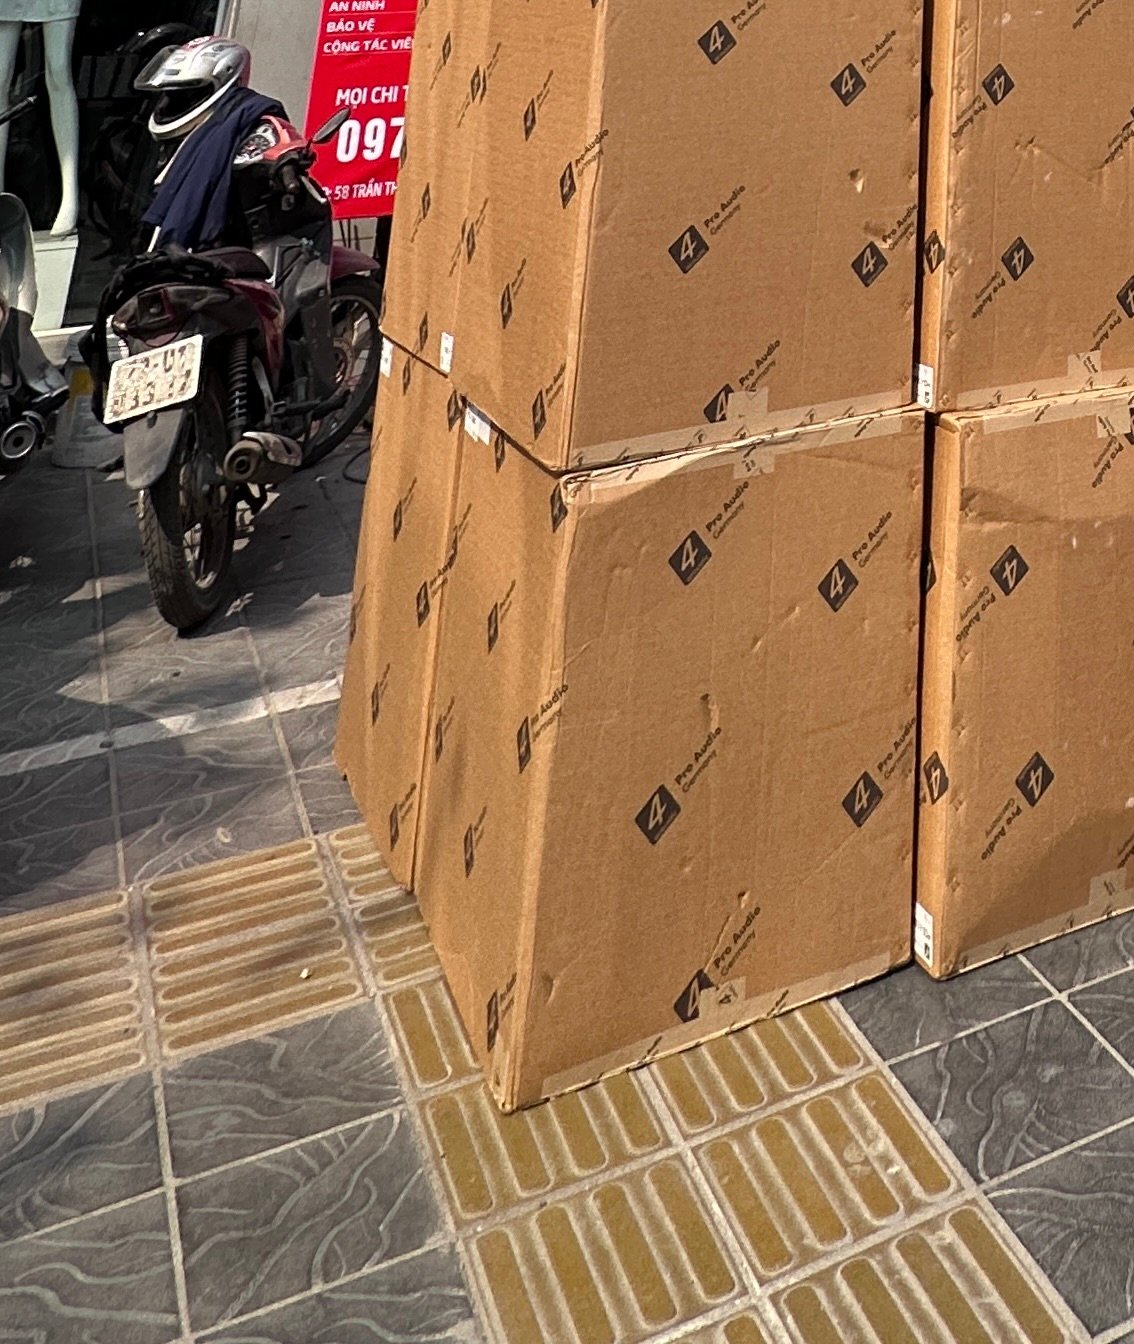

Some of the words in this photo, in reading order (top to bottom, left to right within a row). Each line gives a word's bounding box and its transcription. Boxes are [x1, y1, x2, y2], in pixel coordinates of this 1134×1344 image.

[329, 2, 349, 12] AN
[351, 0, 386, 11] NINH
[358, 18, 376, 32] VỆ
[323, 39, 360, 55] CỘNG
[363, 38, 388, 51] TÁC
[391, 36, 413, 50] VIÊ
[335, 87, 368, 109] MỌI
[370, 86, 399, 103] CHI
[336, 117, 405, 163] 097
[334, 184, 350, 200] 58
